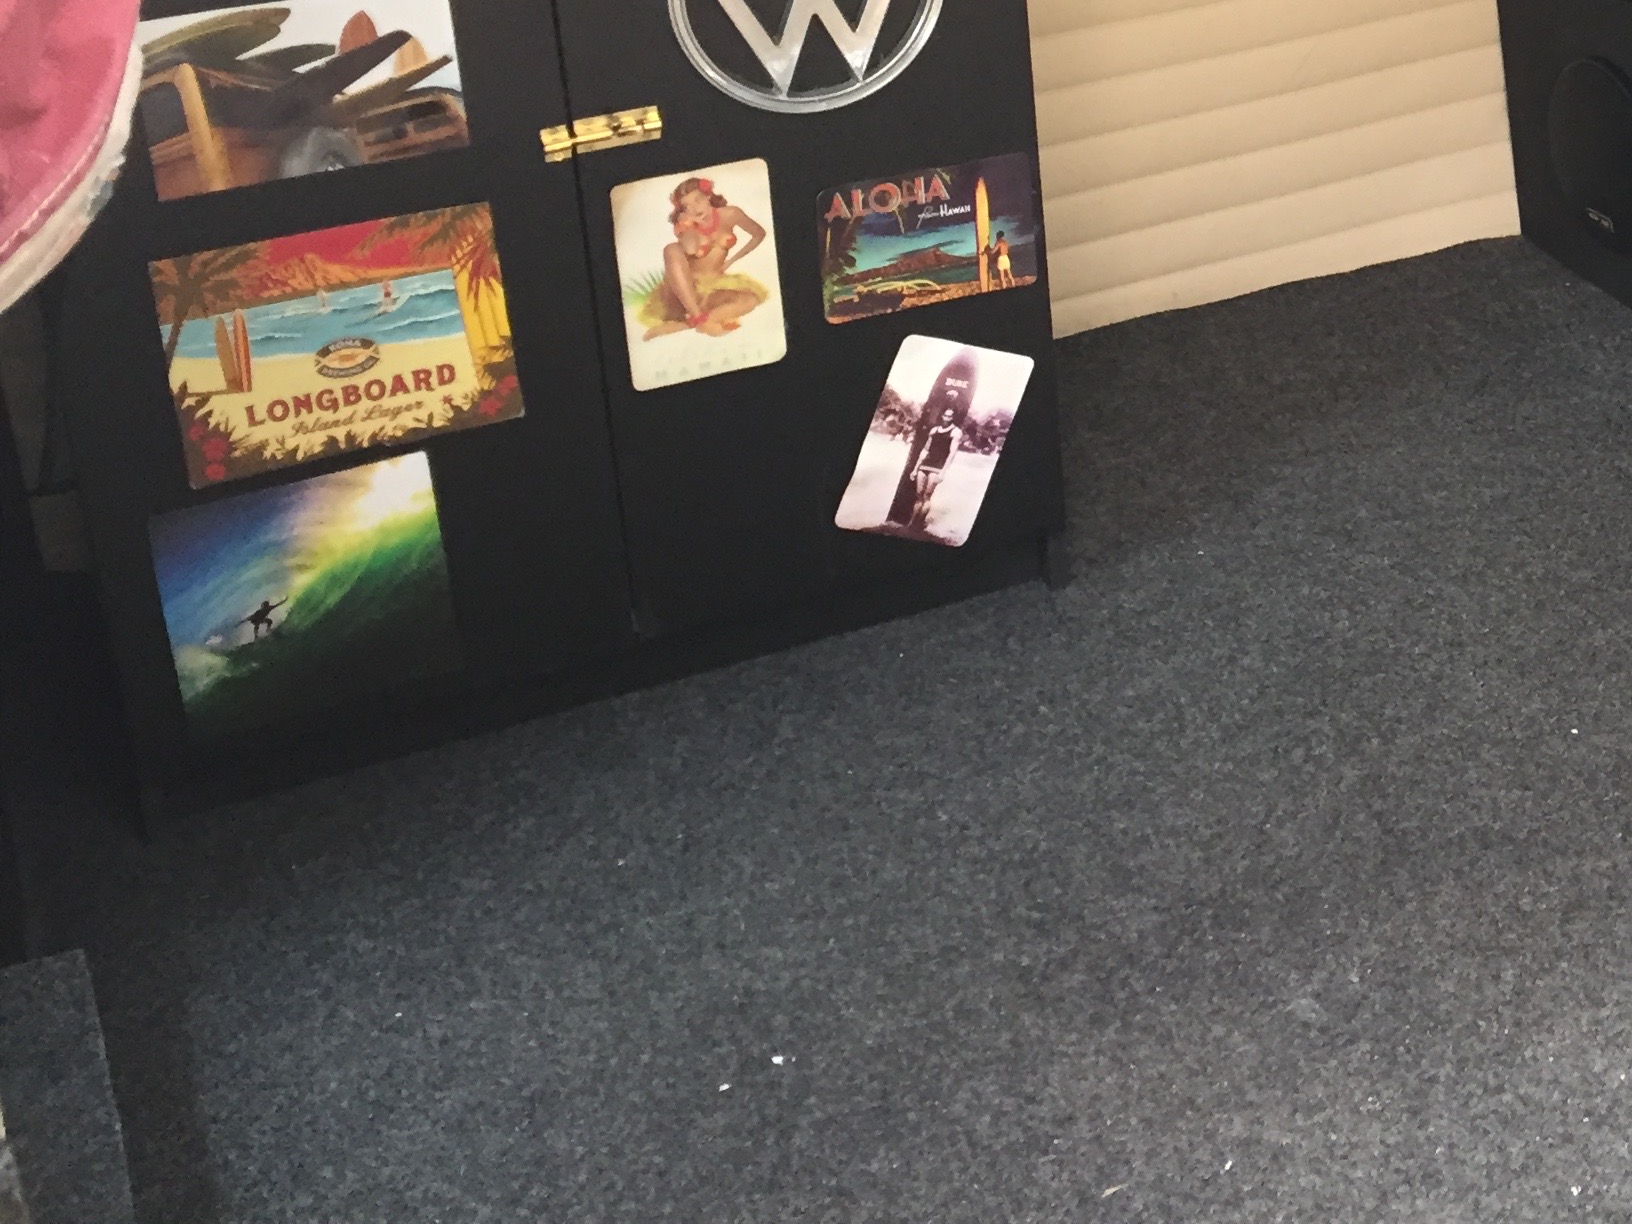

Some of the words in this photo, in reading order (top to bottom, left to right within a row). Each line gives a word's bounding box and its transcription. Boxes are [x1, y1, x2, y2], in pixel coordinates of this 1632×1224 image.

[824, 174, 951, 223] ALOHA
[244, 363, 456, 427] LONGBOARD
[291, 409, 357, 438] Island
[360, 400, 424, 422] Lager
